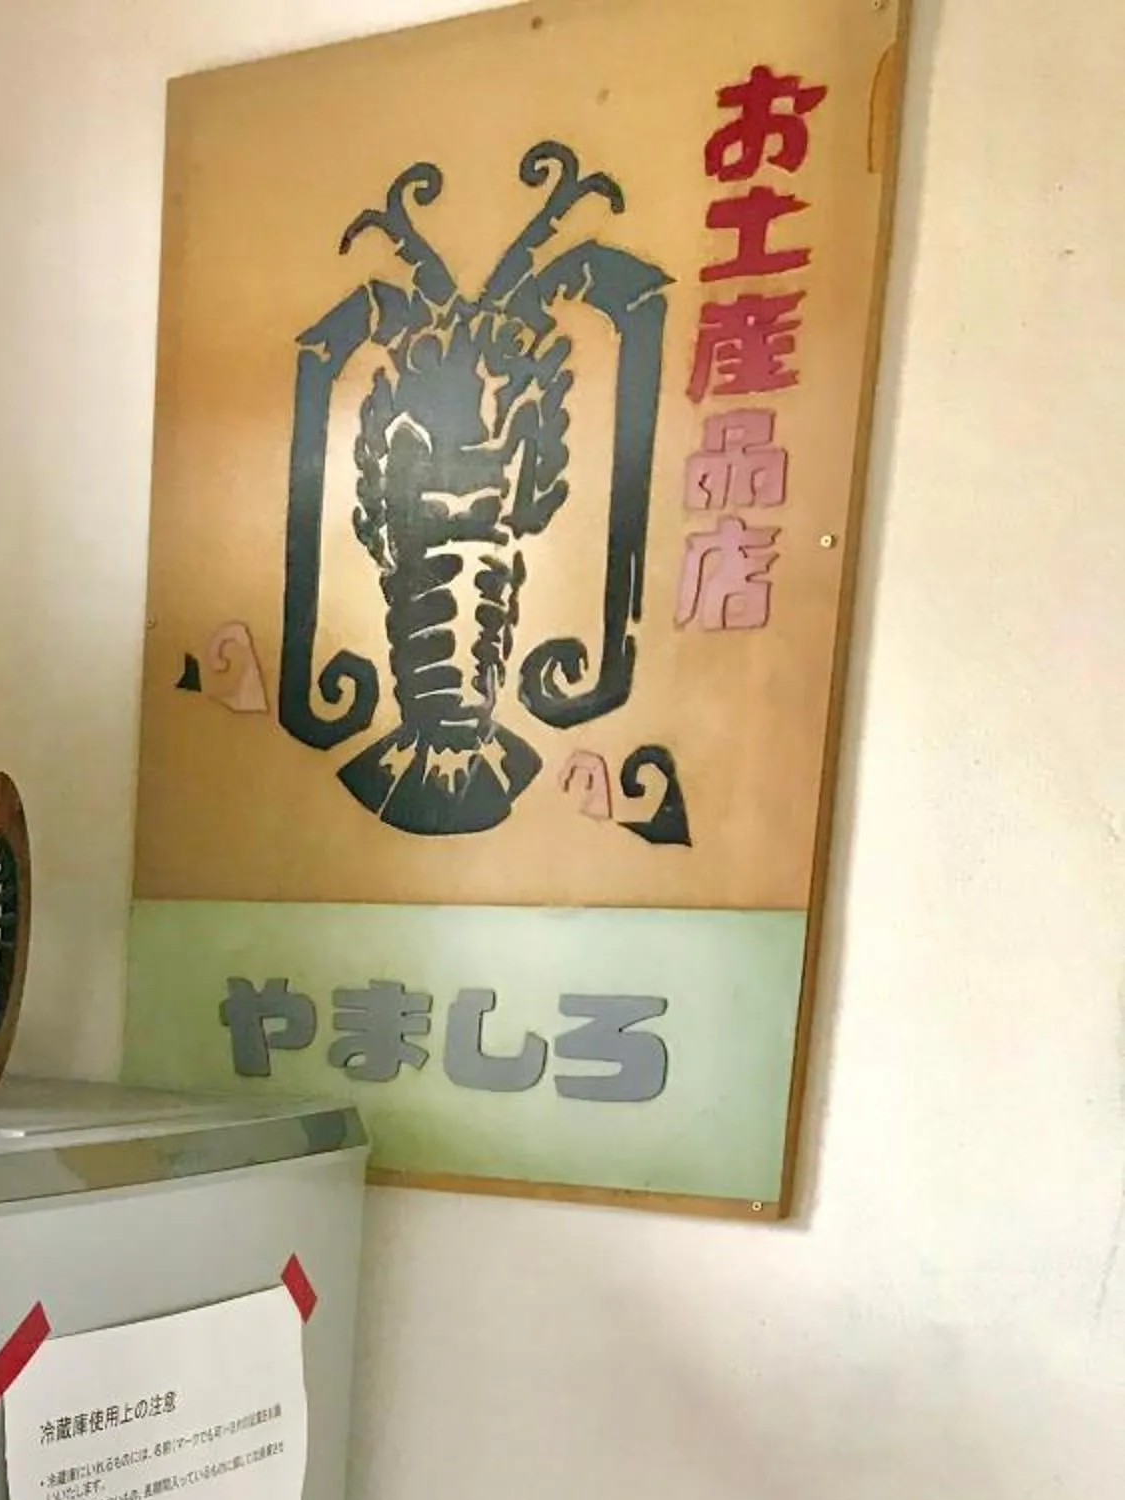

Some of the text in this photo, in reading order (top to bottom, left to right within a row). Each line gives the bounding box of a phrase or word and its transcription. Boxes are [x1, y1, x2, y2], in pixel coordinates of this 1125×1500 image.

[676, 64, 828, 632] お土産品店
[218, 976, 670, 1103] やましろ
[40, 1390, 177, 1445] 冷蔵庫使用上の注意
